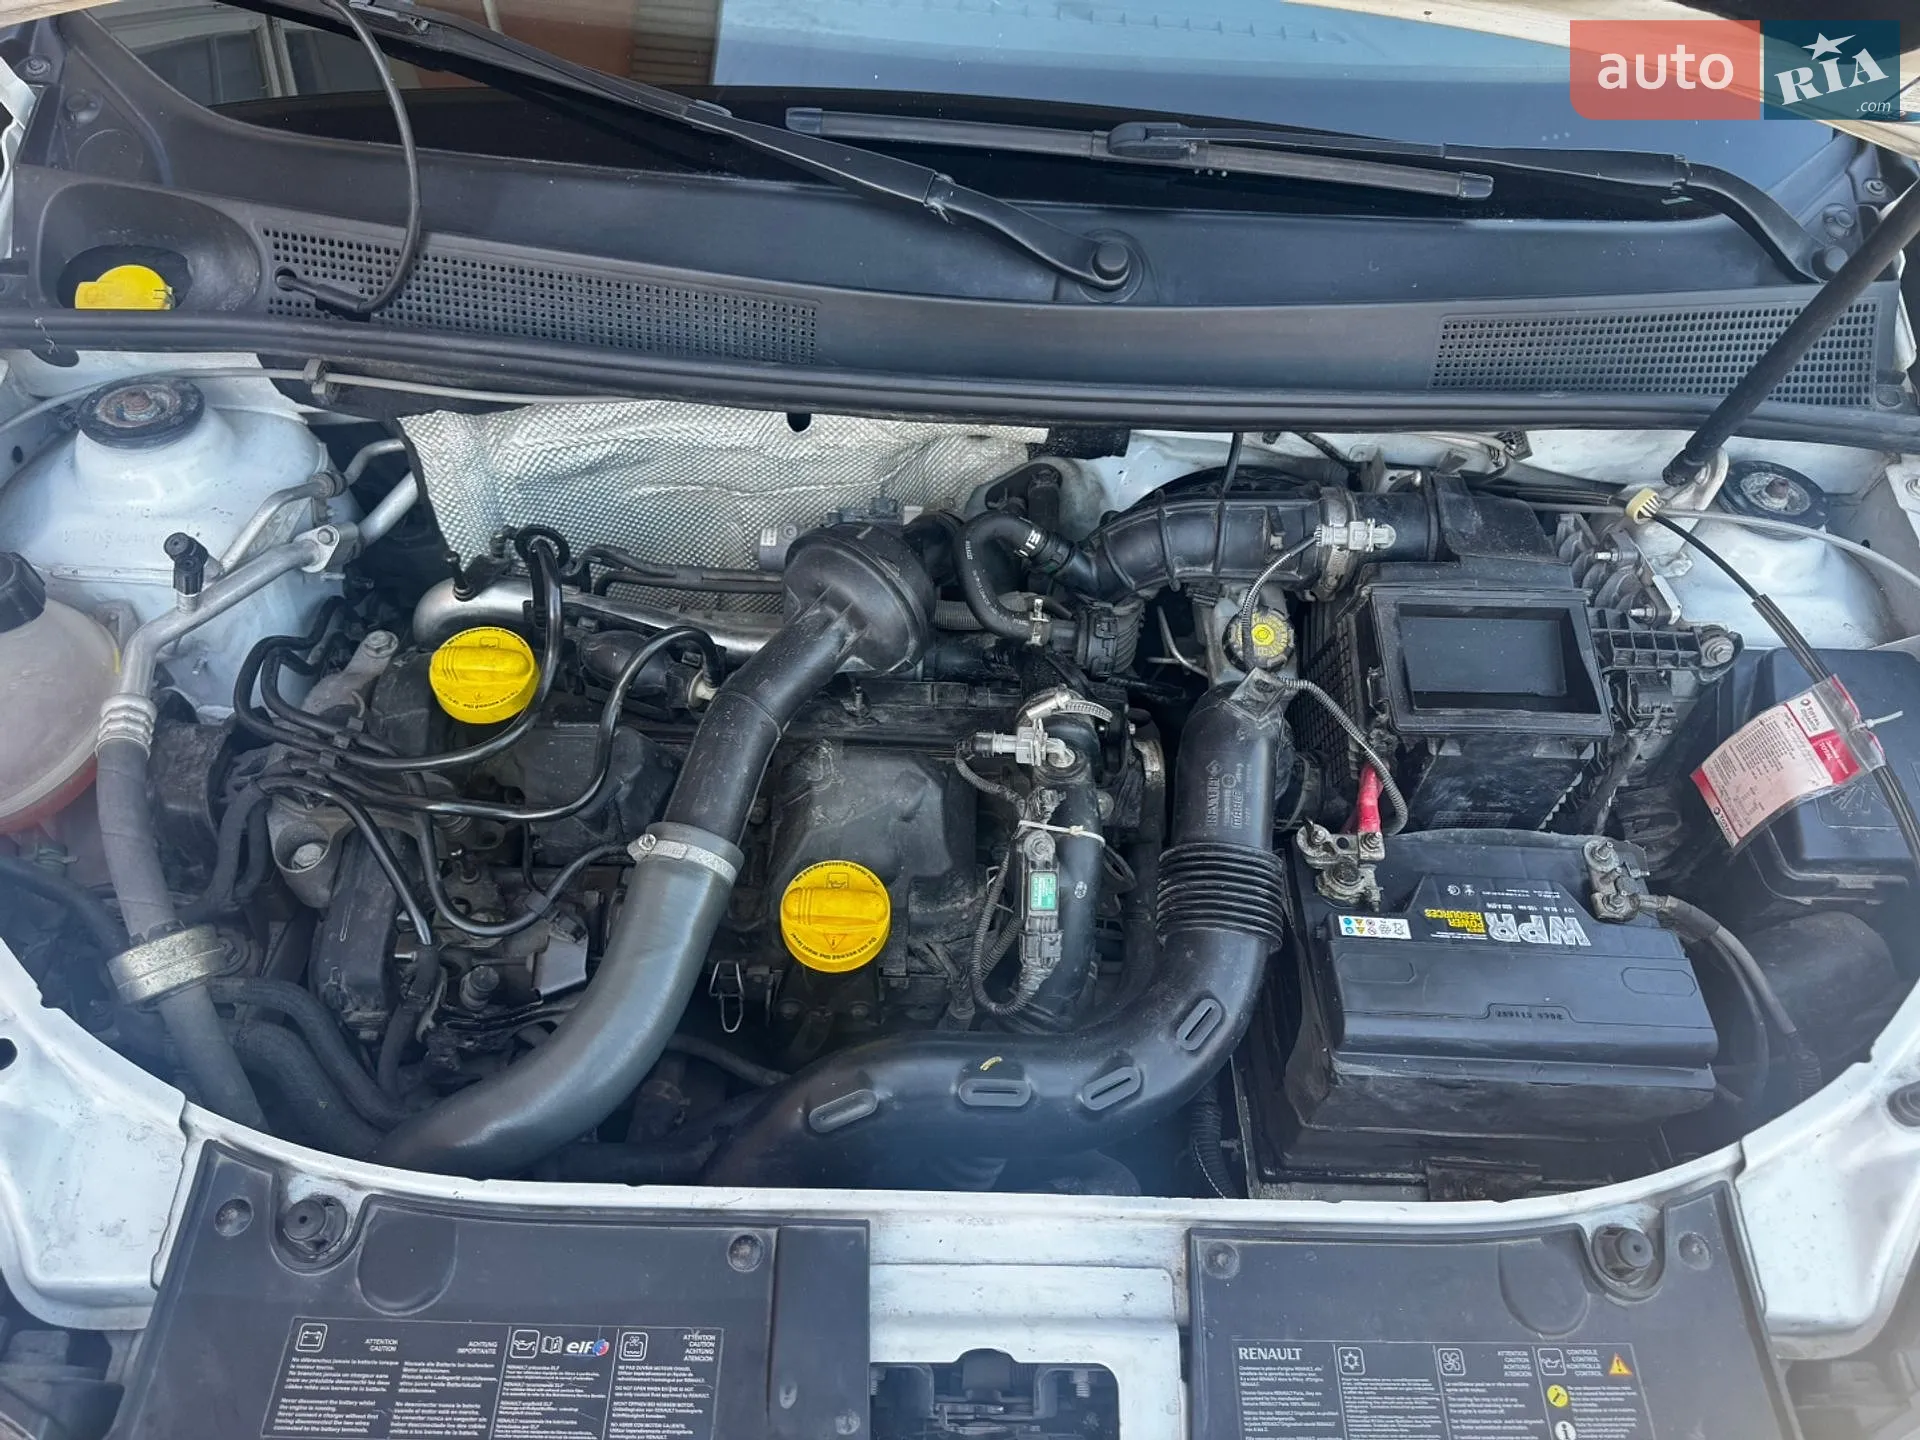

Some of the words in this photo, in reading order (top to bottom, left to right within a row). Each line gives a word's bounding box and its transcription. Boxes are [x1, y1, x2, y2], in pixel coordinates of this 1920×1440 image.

[1424, 909, 1483, 919] RESOURCES
[1448, 919, 1484, 928] POWER
[1484, 912, 1592, 946] WPR
[566, 1341, 594, 1354] elf
[1238, 1348, 1302, 1360] RENAULT
